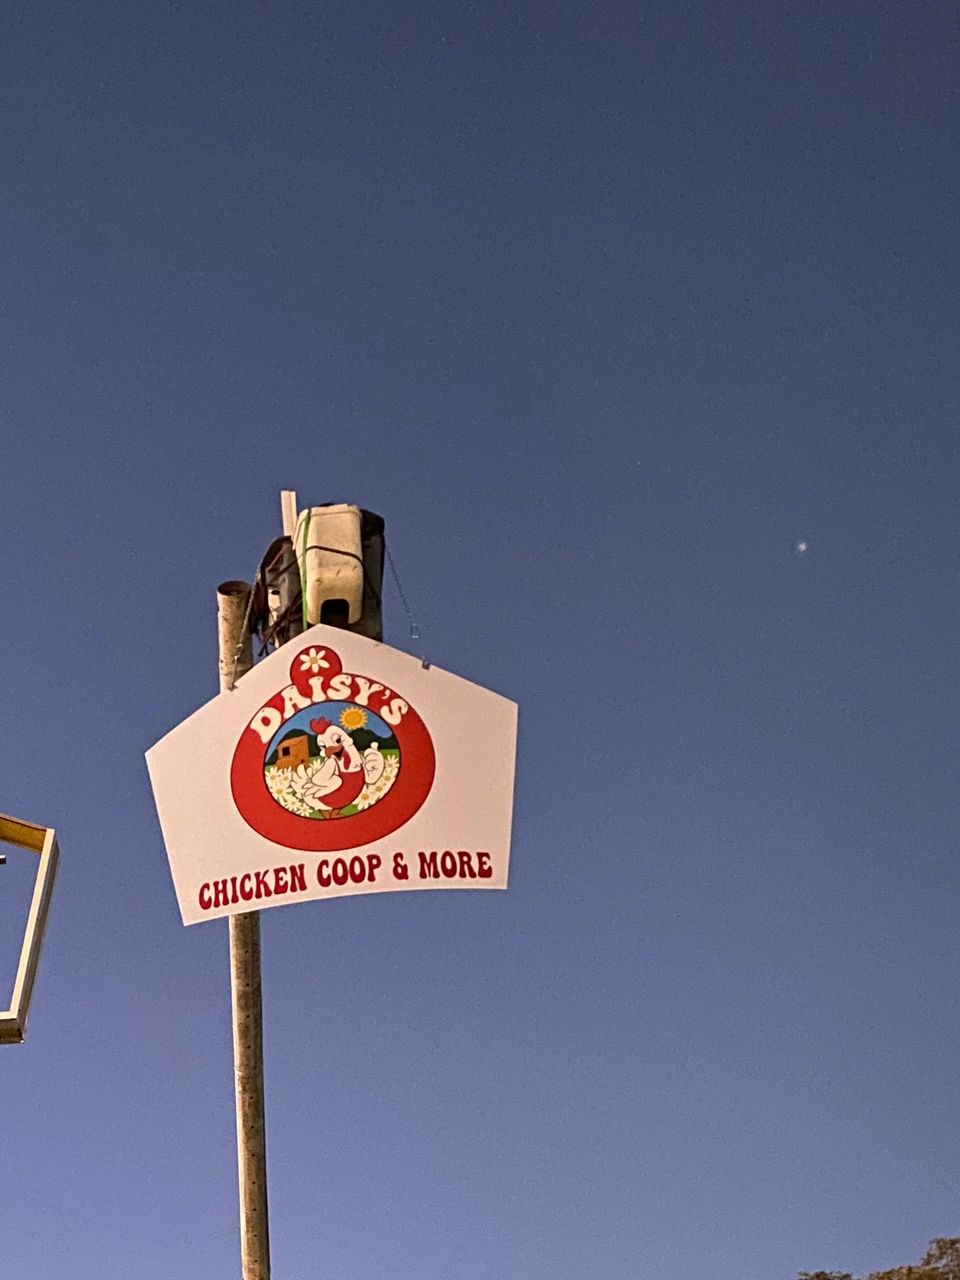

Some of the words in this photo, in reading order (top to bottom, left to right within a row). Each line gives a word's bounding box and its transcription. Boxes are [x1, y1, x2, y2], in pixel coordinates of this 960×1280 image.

[250, 675, 409, 744] DAISY'S
[198, 863, 306, 911] CHICKEN
[317, 853, 382, 887] COOP
[392, 853, 409, 880] &
[418, 851, 493, 879] MORE
